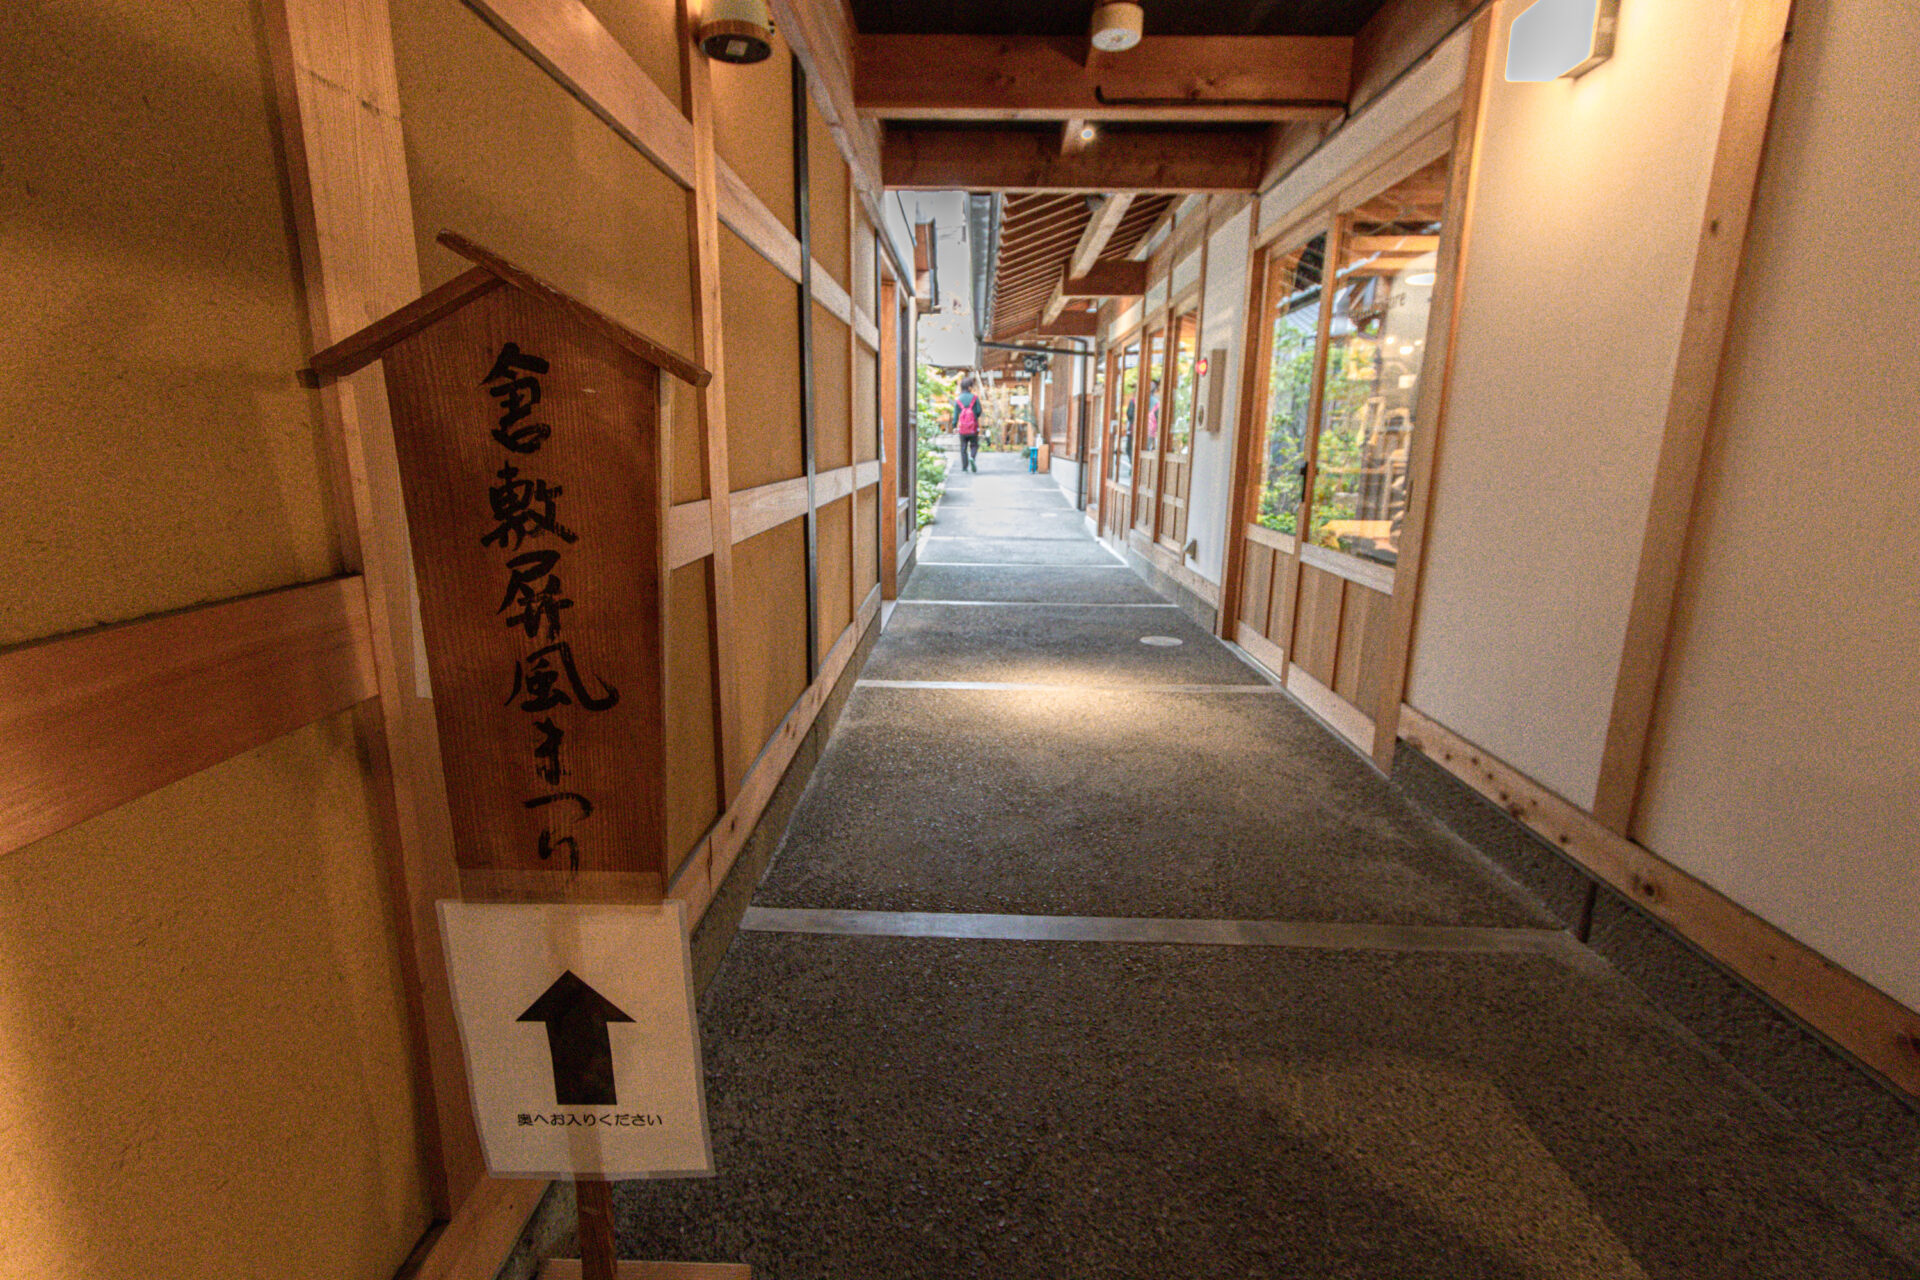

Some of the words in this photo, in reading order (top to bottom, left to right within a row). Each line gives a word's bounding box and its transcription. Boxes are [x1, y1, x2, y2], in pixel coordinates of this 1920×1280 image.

[518, 1112, 662, 1126] 奥へお入りください
